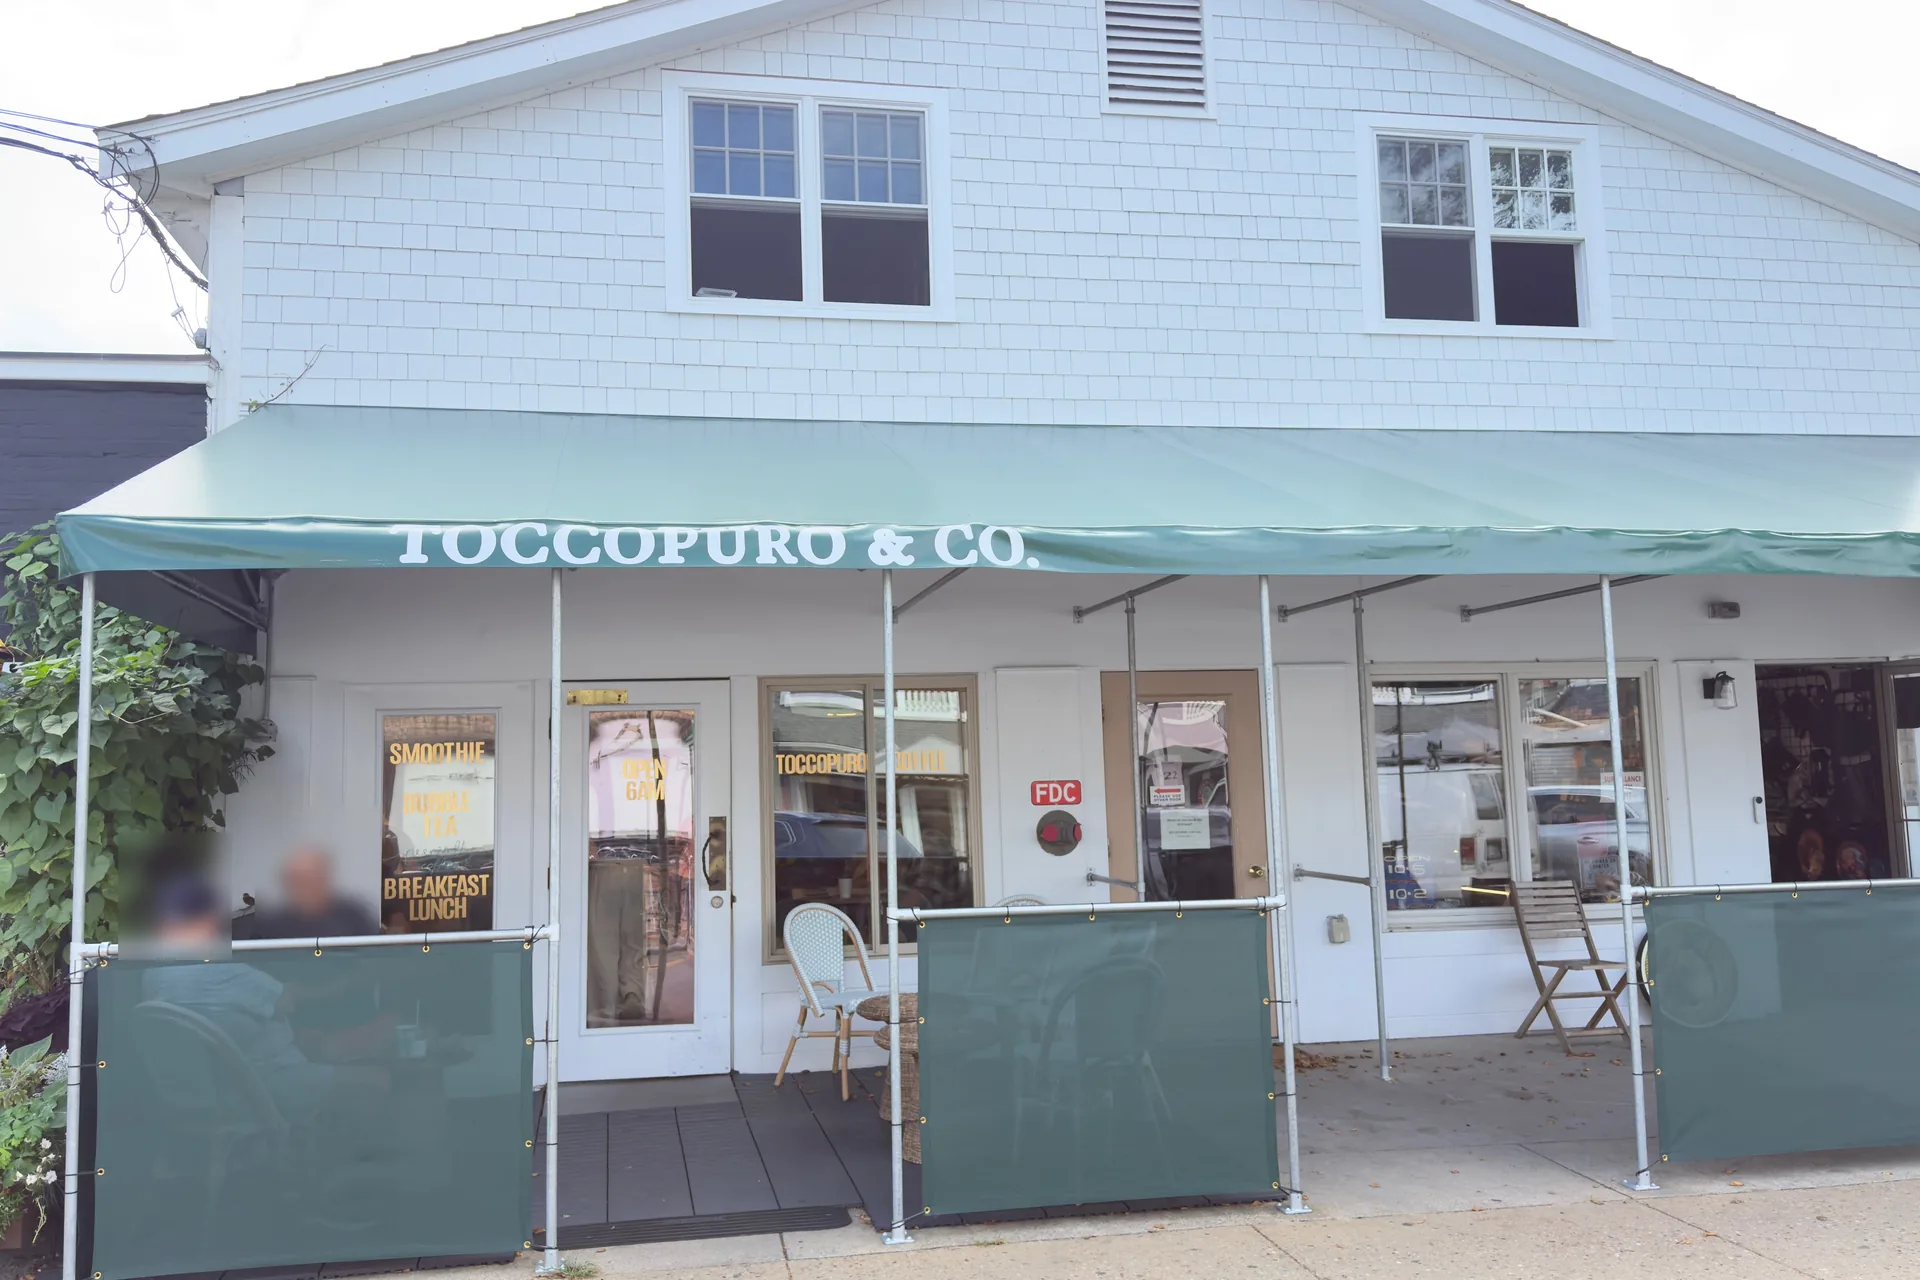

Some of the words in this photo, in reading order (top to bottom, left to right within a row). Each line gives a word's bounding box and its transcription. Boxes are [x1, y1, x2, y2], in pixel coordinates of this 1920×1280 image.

[388, 521, 847, 566] TOCCOPURO
[867, 527, 915, 567] &
[934, 524, 1040, 569] CO.
[389, 741, 486, 765] SMOOTHIE
[775, 752, 869, 775] TOCCOPURO
[622, 758, 668, 779] OPEN
[625, 779, 665, 801] 6AM
[1035, 782, 1077, 803] FDC
[403, 790, 471, 815] BUBBLE
[423, 815, 458, 838] TEA
[1384, 855, 1431, 863] OPEN
[384, 874, 490, 900] BREAKFAST
[409, 897, 468, 921] LUNCH
